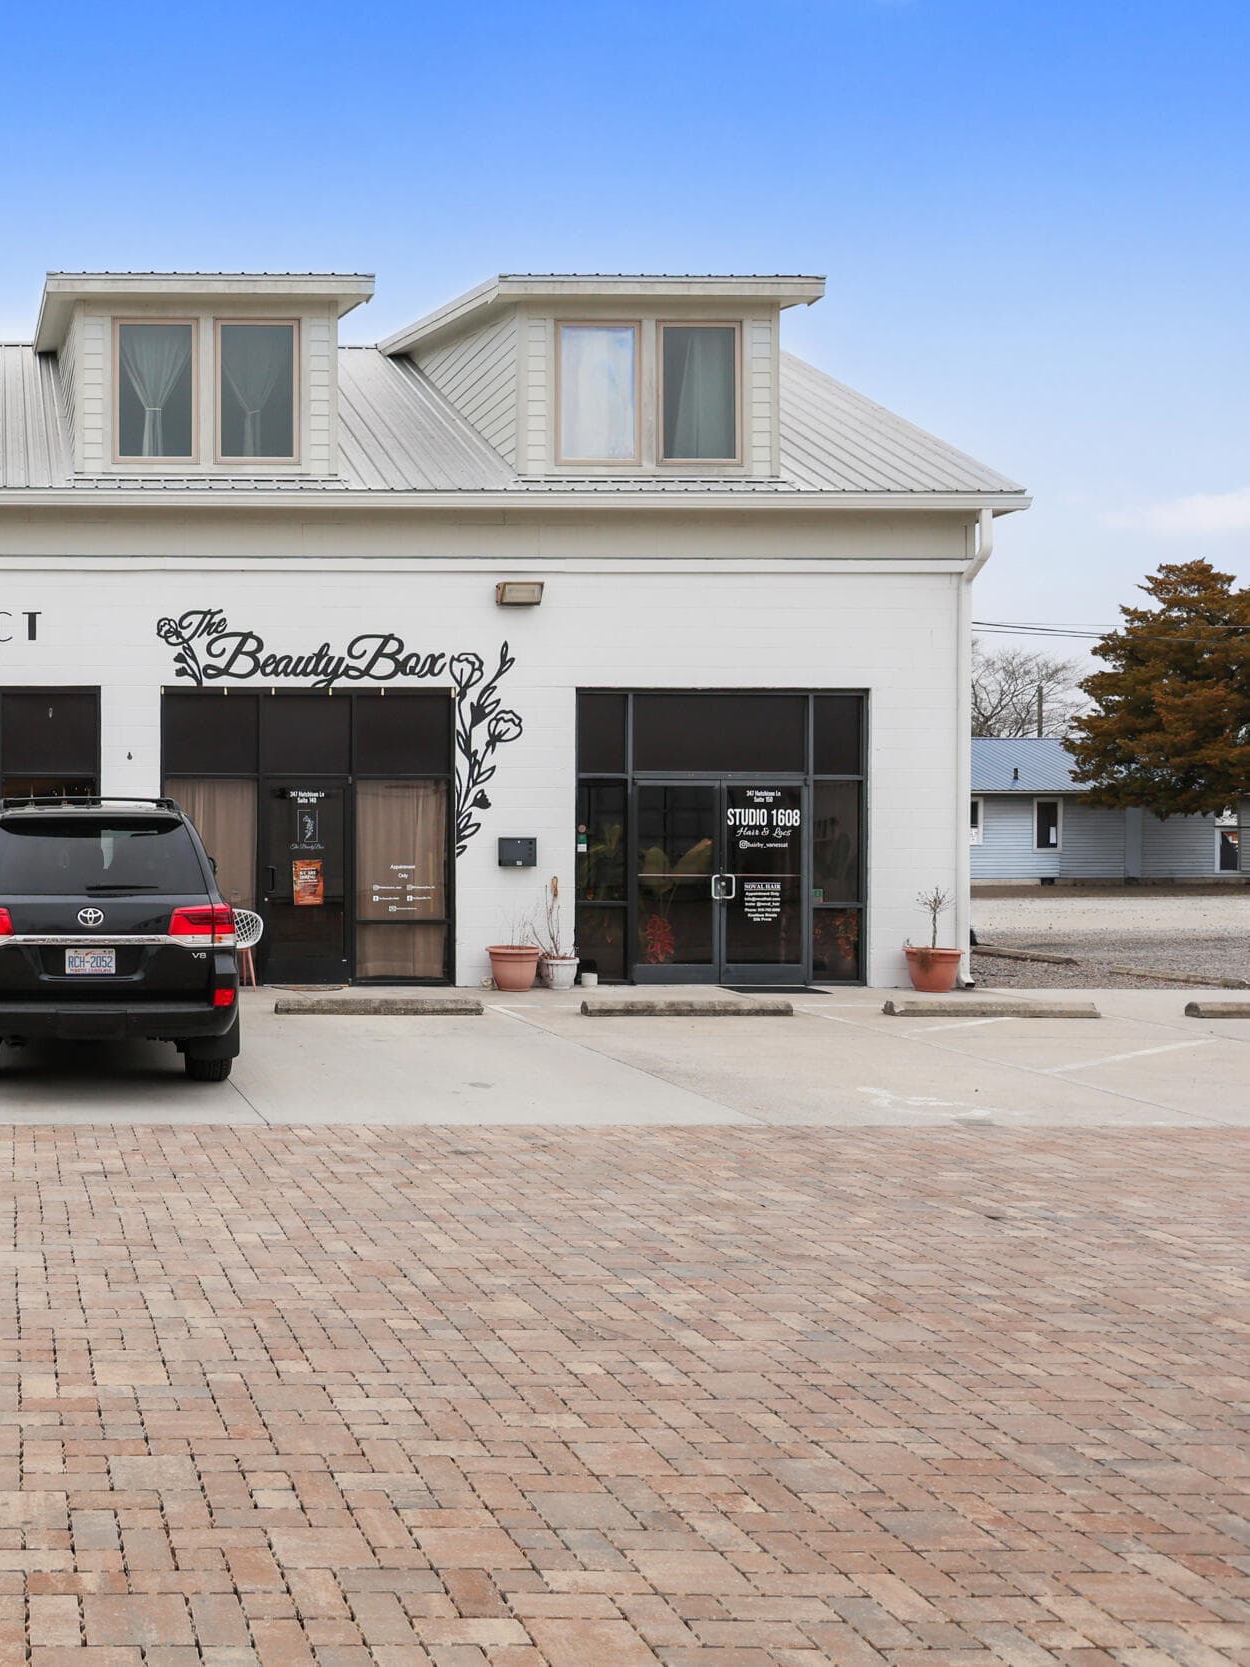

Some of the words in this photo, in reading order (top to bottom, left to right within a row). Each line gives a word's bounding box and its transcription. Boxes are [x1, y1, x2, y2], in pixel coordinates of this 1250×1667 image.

[177, 608, 228, 639] The
[202, 631, 348, 688] Beauty
[344, 633, 447, 681] Box
[727, 808, 768, 826] STUDIO
[771, 808, 801, 827] 1608
[735, 826, 760, 837] Hair
[772, 827, 792, 839] Locs
[68, 955, 113, 968] RCH-2052
